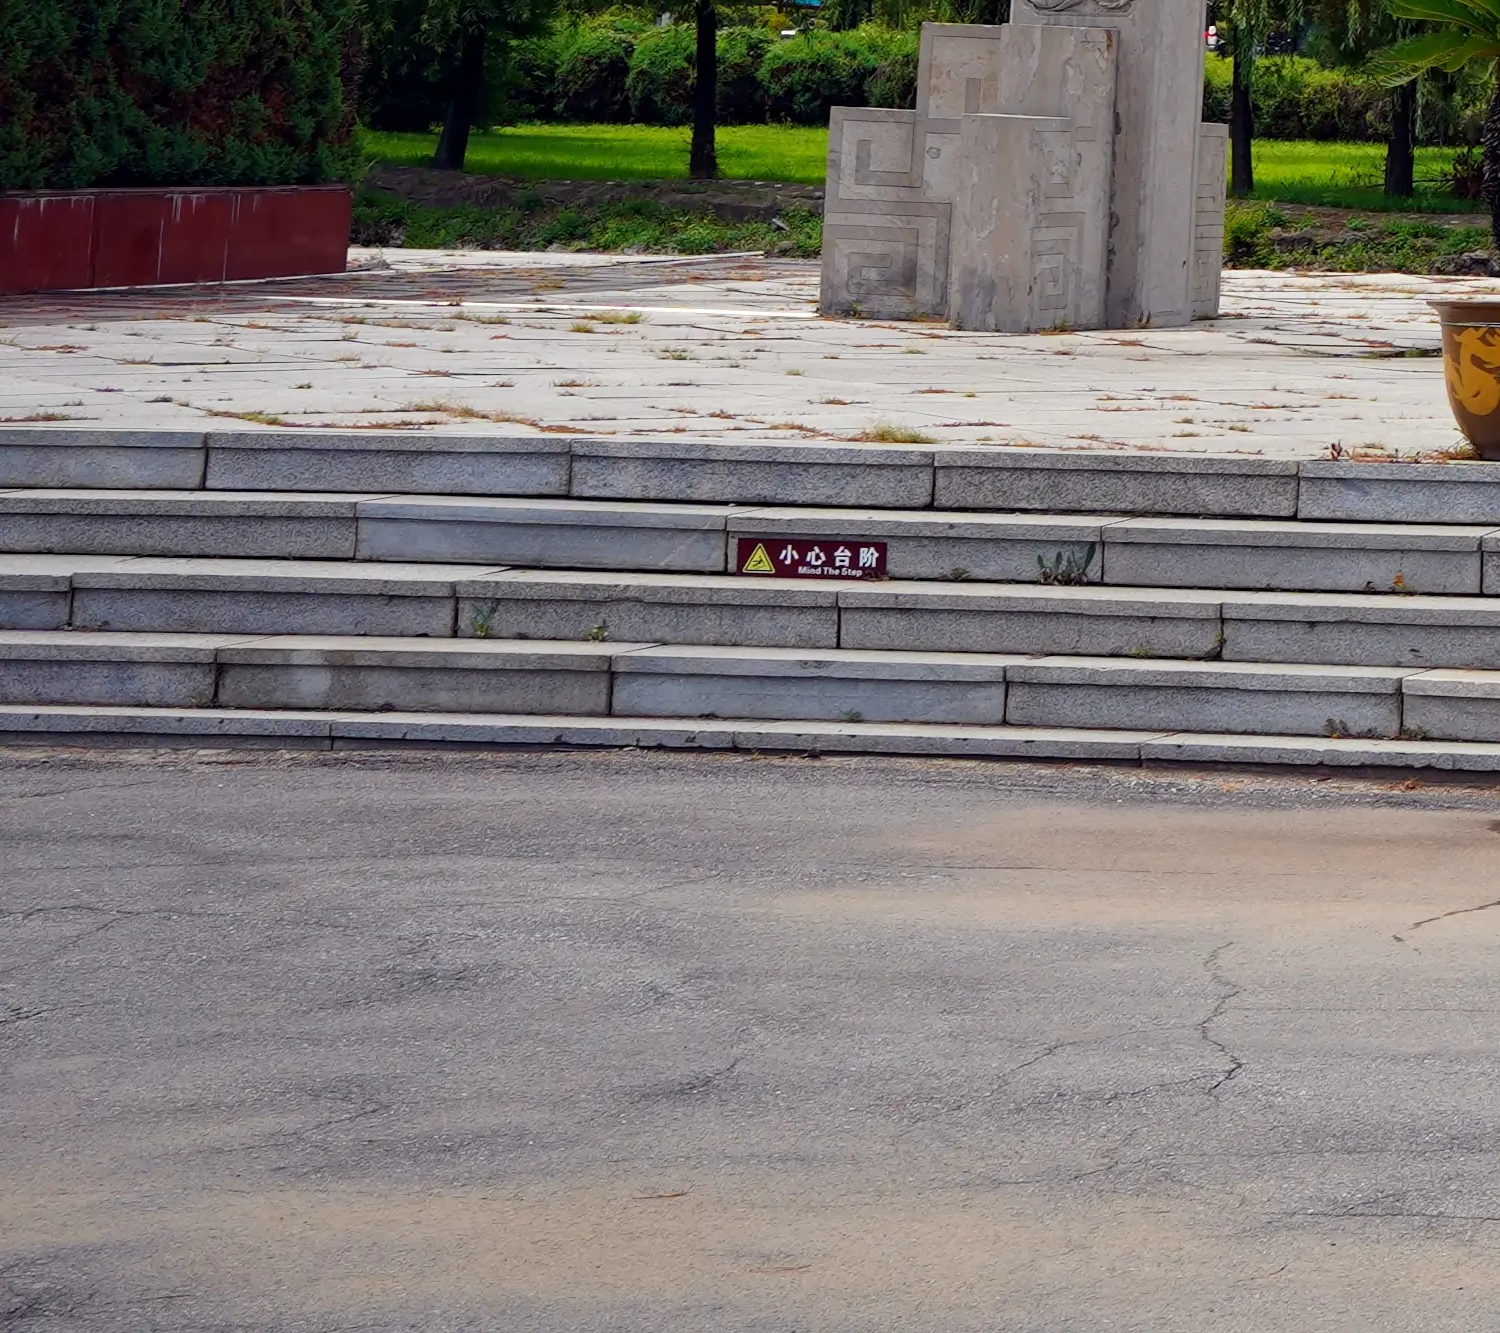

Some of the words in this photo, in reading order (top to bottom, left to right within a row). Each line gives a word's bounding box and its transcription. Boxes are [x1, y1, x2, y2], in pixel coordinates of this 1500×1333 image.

[779, 544, 879, 567] 小心台阶
[798, 566, 821, 575] Mind
[823, 566, 840, 576] The
[841, 567, 863, 578] Step
